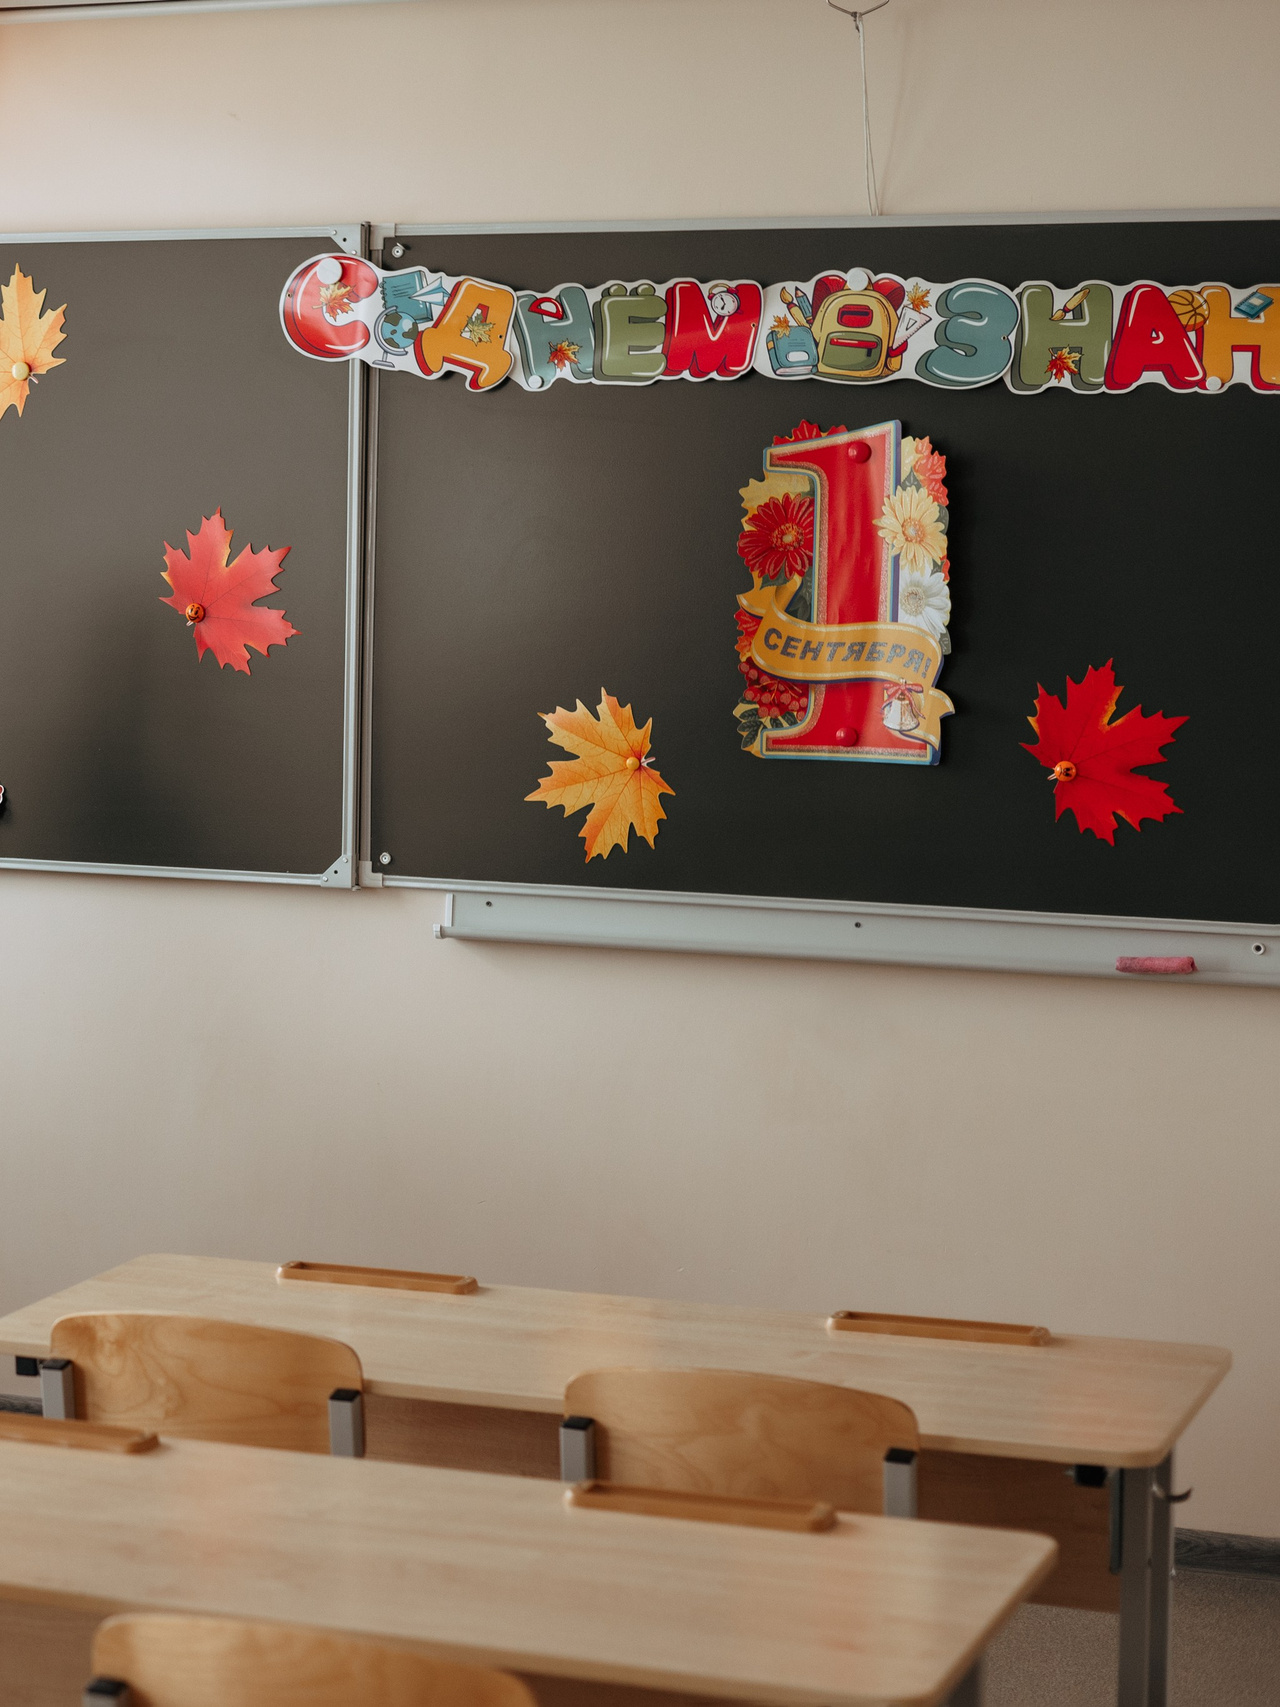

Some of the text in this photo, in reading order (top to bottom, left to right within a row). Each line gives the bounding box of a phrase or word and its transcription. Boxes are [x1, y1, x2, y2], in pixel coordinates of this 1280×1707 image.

[282, 254, 379, 359] С
[762, 420, 936, 765] 1
[763, 627, 932, 679] СЕНТЯБРЯ!
